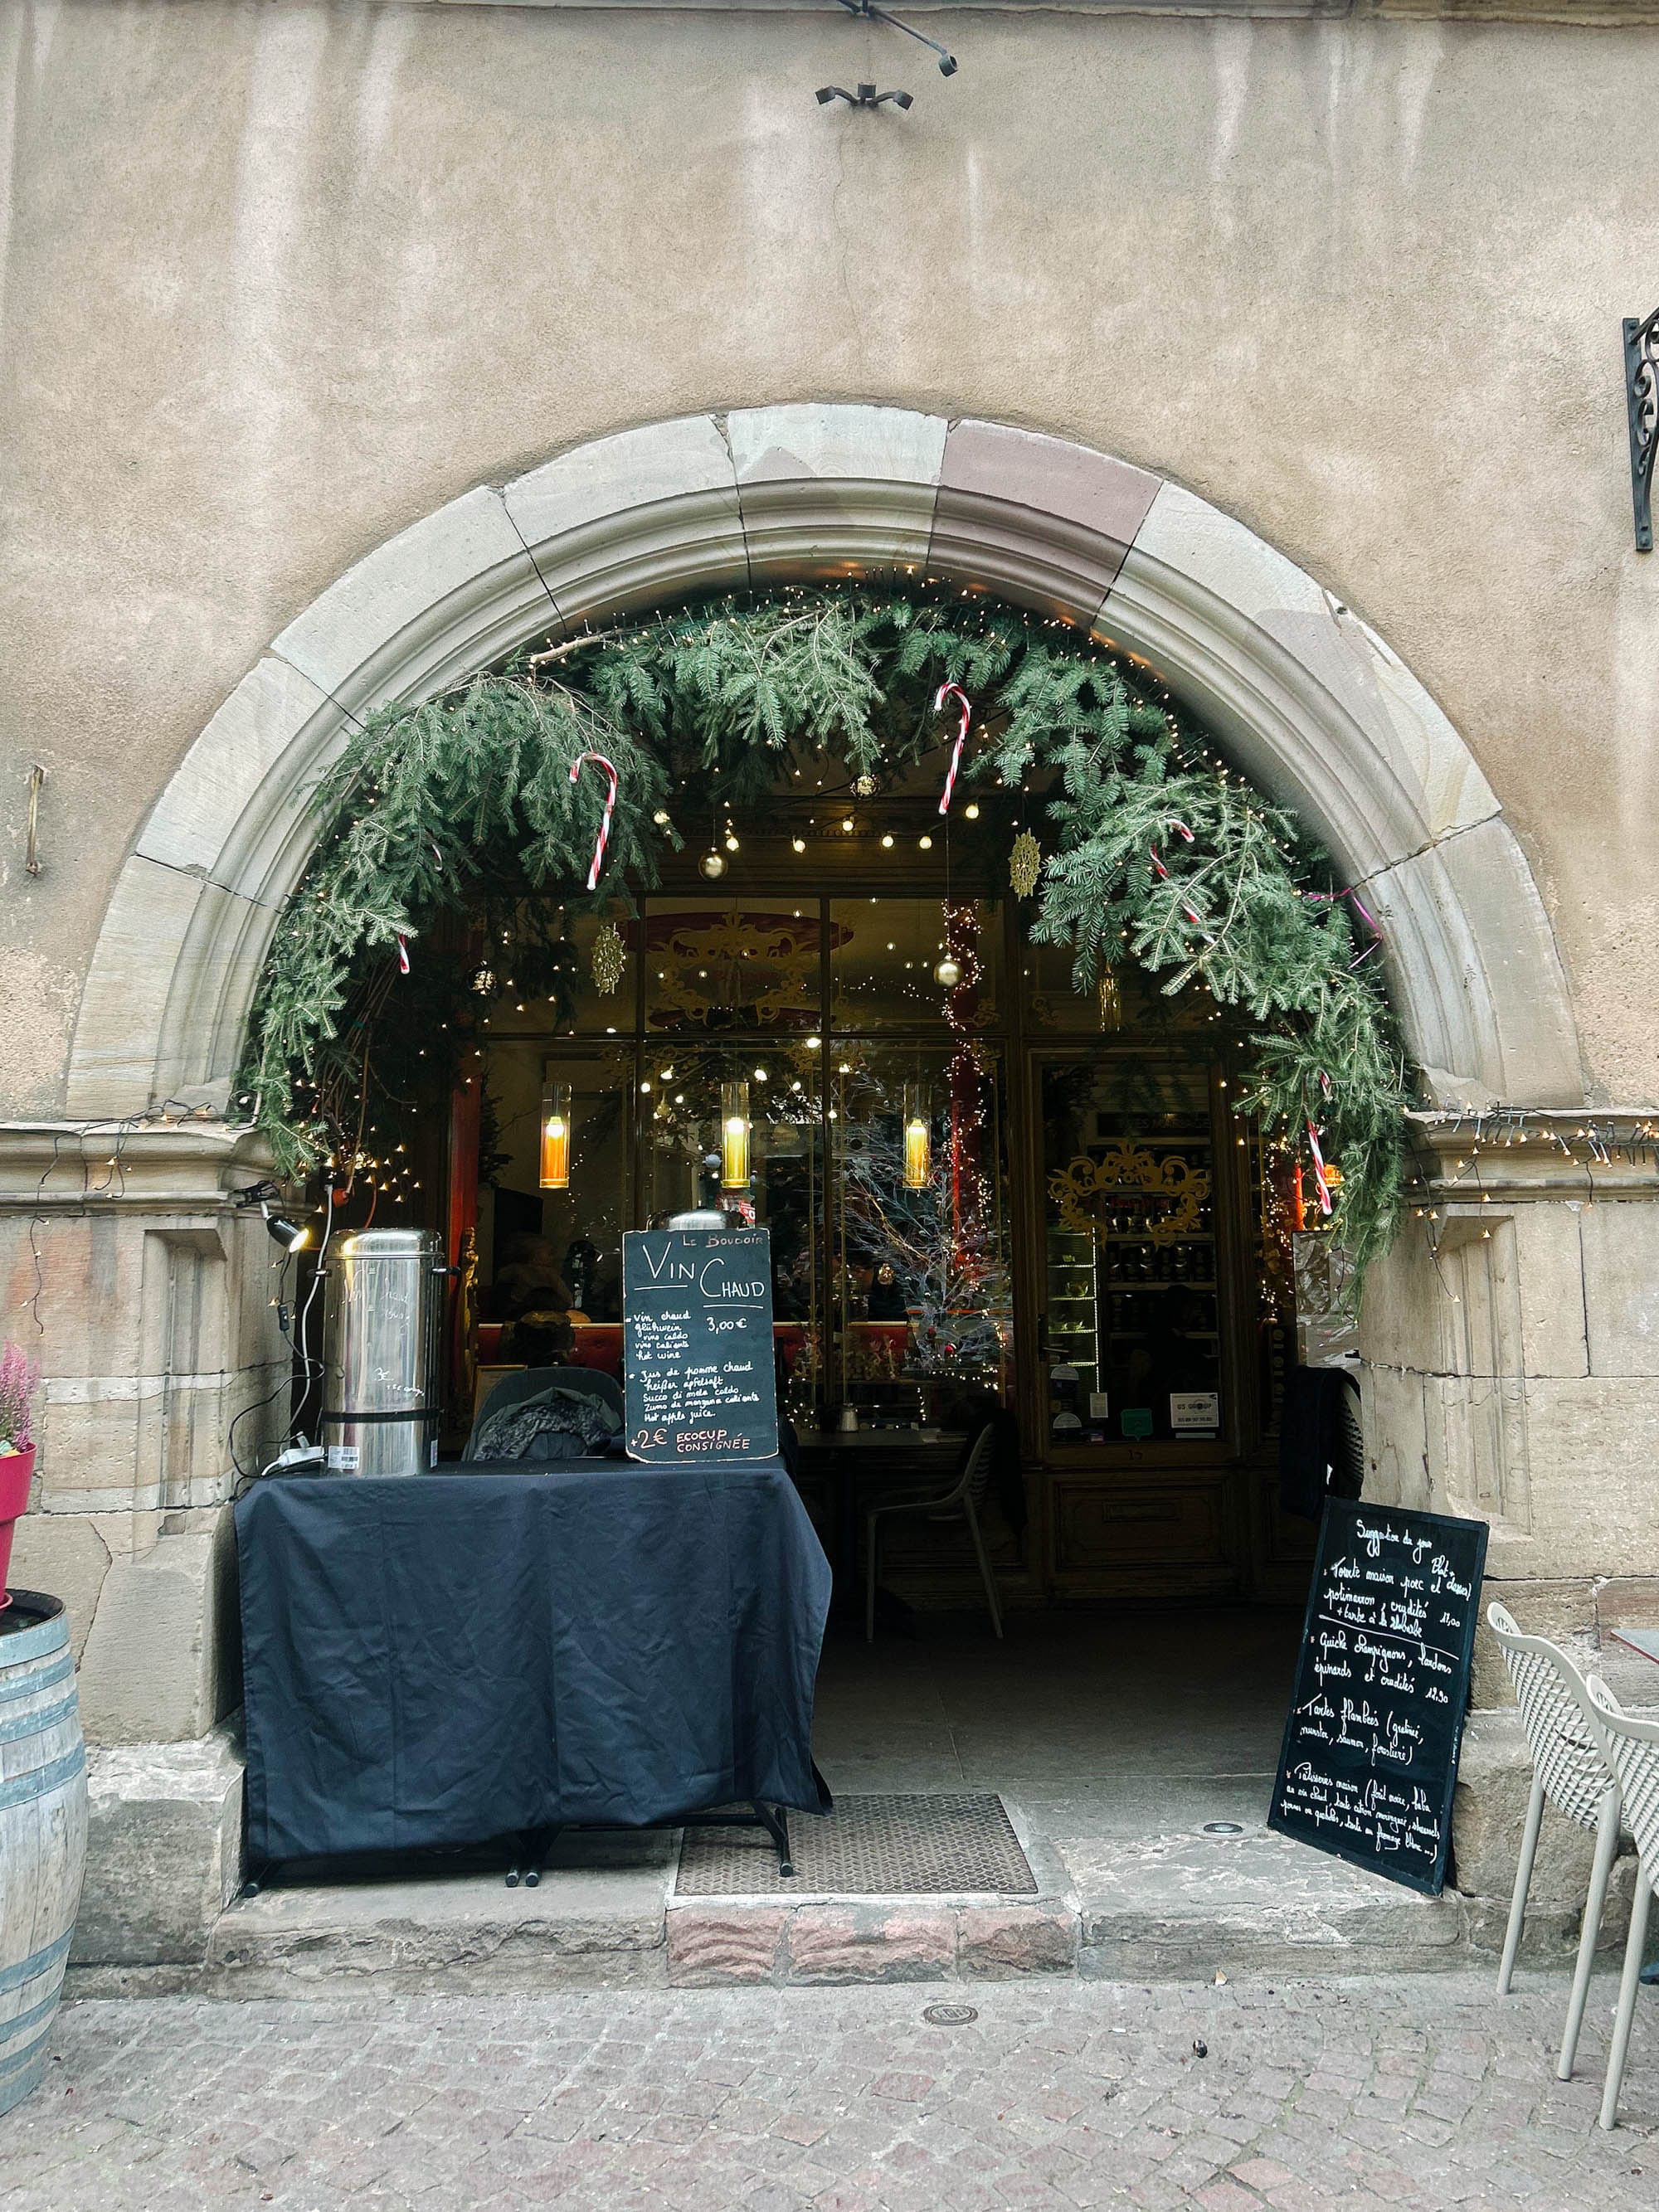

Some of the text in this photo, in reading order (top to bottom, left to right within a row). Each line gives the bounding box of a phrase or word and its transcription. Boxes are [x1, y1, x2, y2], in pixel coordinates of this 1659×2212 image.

[661, 1310, 691, 1321] chaud
[664, 1332, 688, 1341] caldo
[635, 1349, 682, 1361] hot wine
[666, 1368, 679, 1377] de
[684, 1364, 719, 1379] pomme
[722, 1361, 753, 1373] chaud
[673, 1391, 683, 1401] di
[714, 1385, 739, 1396] caldo
[661, 1411, 686, 1425] apple
[676, 1429, 727, 1443] ECOCUP
[1365, 1568, 1394, 1585] maison
[1400, 1576, 1424, 1598] porc
[1365, 1667, 1375, 1682] et
